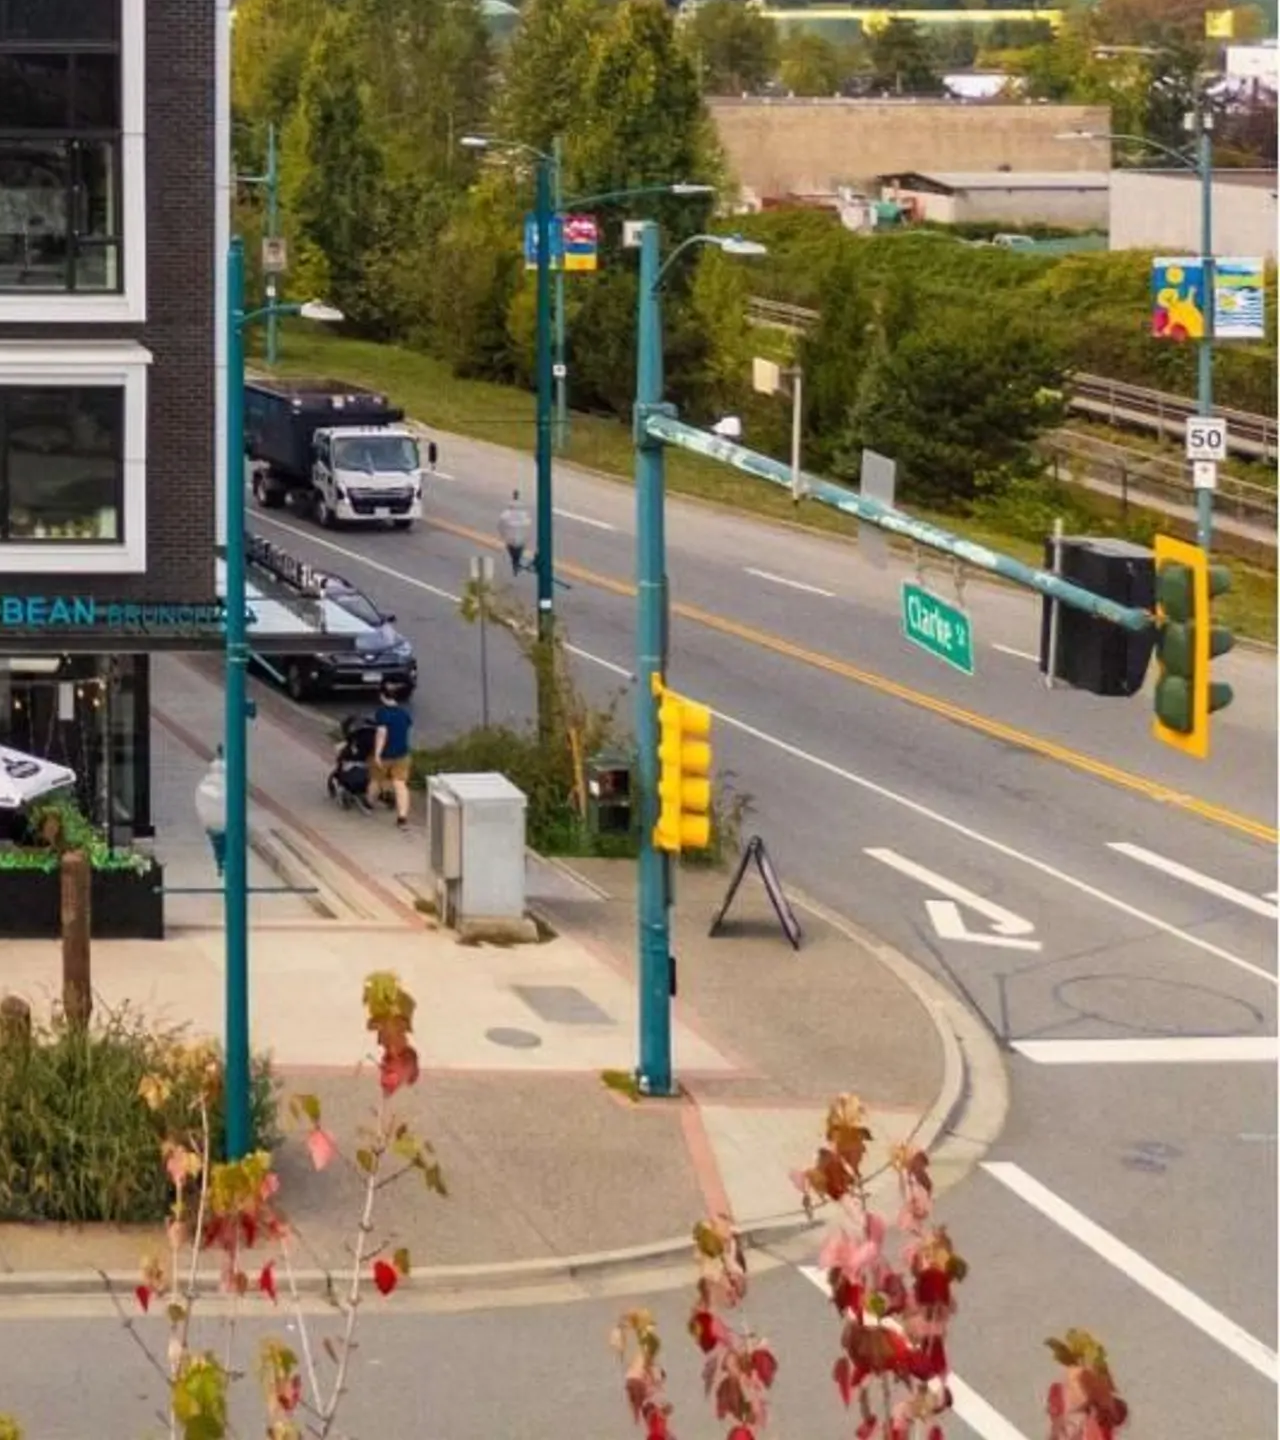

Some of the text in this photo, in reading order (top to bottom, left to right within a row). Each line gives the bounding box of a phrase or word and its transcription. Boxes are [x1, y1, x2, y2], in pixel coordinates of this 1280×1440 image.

[1191, 429, 1222, 448] 50
[2, 595, 94, 626] BEAN
[909, 596, 953, 651] Clarke
